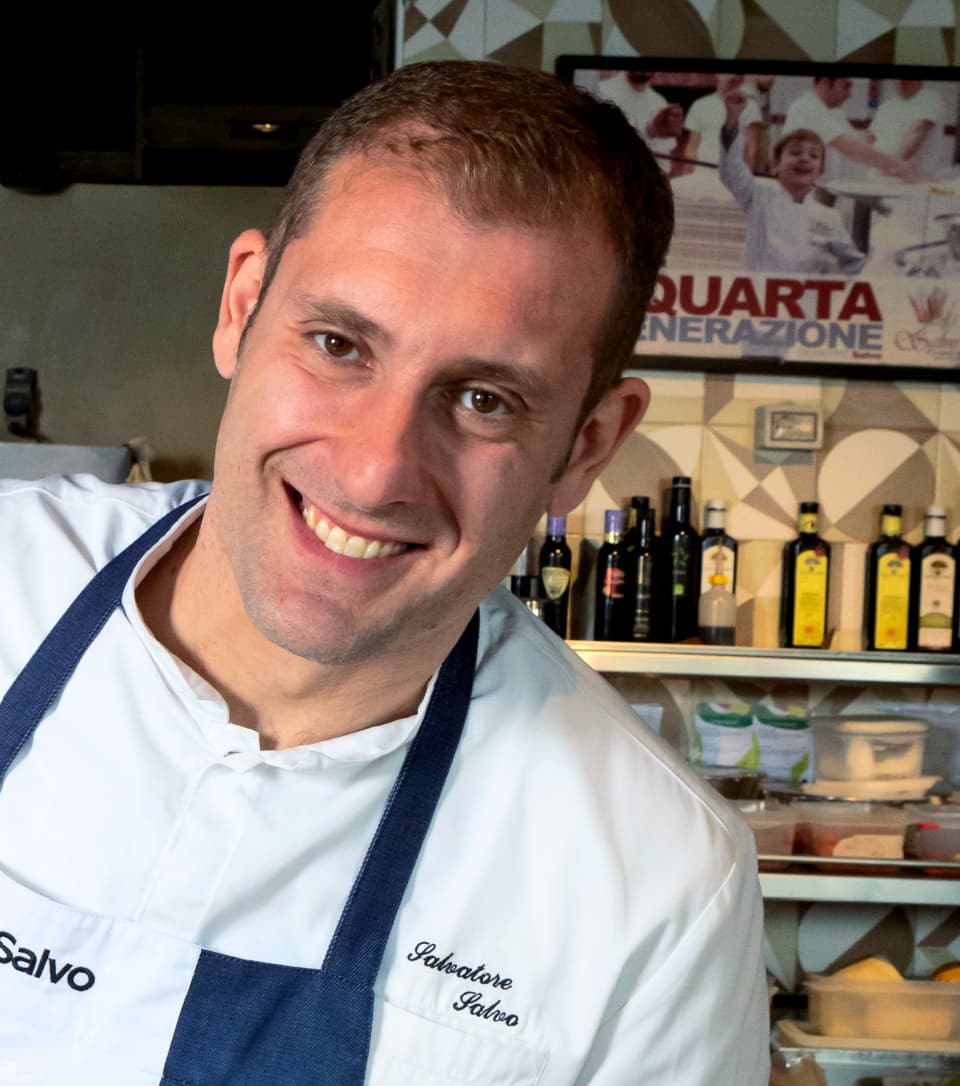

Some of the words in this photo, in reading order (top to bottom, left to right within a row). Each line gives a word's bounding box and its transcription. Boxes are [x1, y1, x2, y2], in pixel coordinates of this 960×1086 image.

[647, 273, 883, 321] QUARTA
[407, 941, 513, 990] Salvatore
[452, 991, 519, 1027] Salvo
